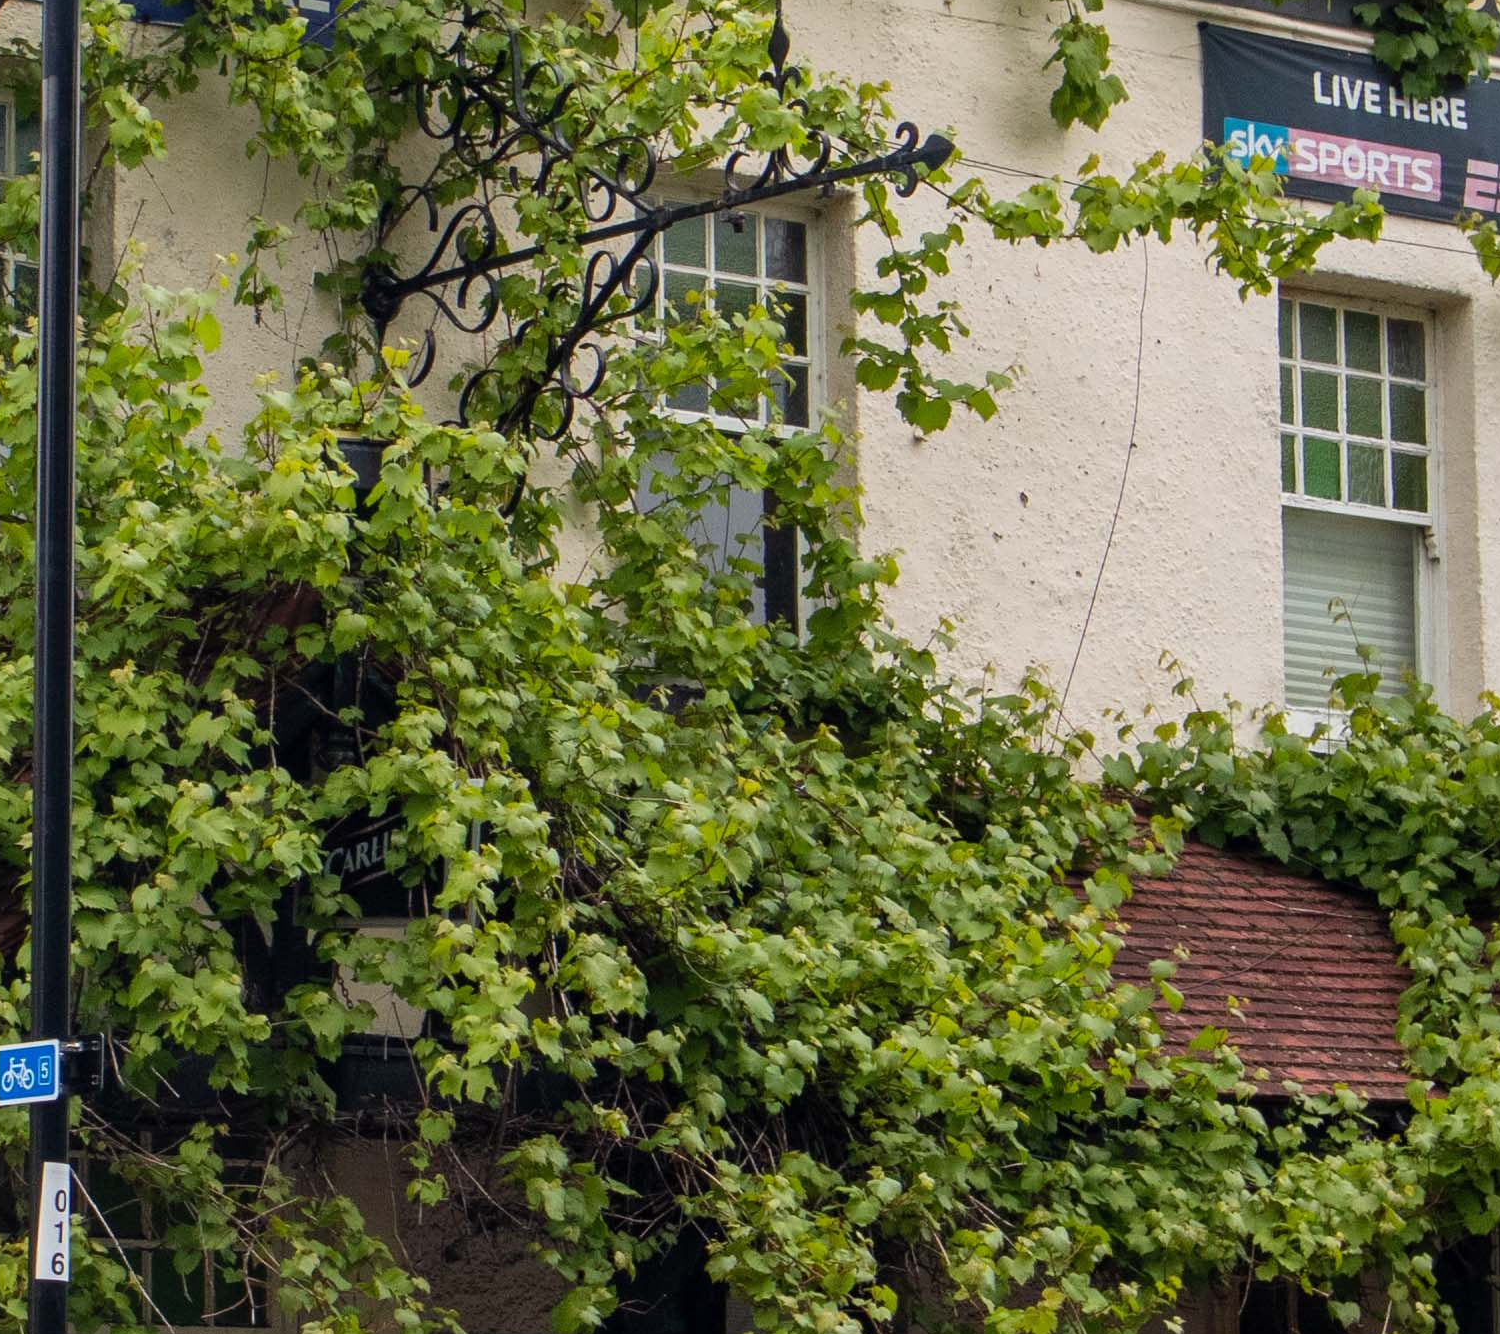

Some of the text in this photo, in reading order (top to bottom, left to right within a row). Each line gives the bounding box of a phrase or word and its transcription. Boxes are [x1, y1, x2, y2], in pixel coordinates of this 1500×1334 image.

[1312, 71, 1470, 131] LIVE HERE
[1229, 122, 1284, 164] sky
[1294, 138, 1434, 193] SPORTS
[41, 1061, 49, 1079] 5
